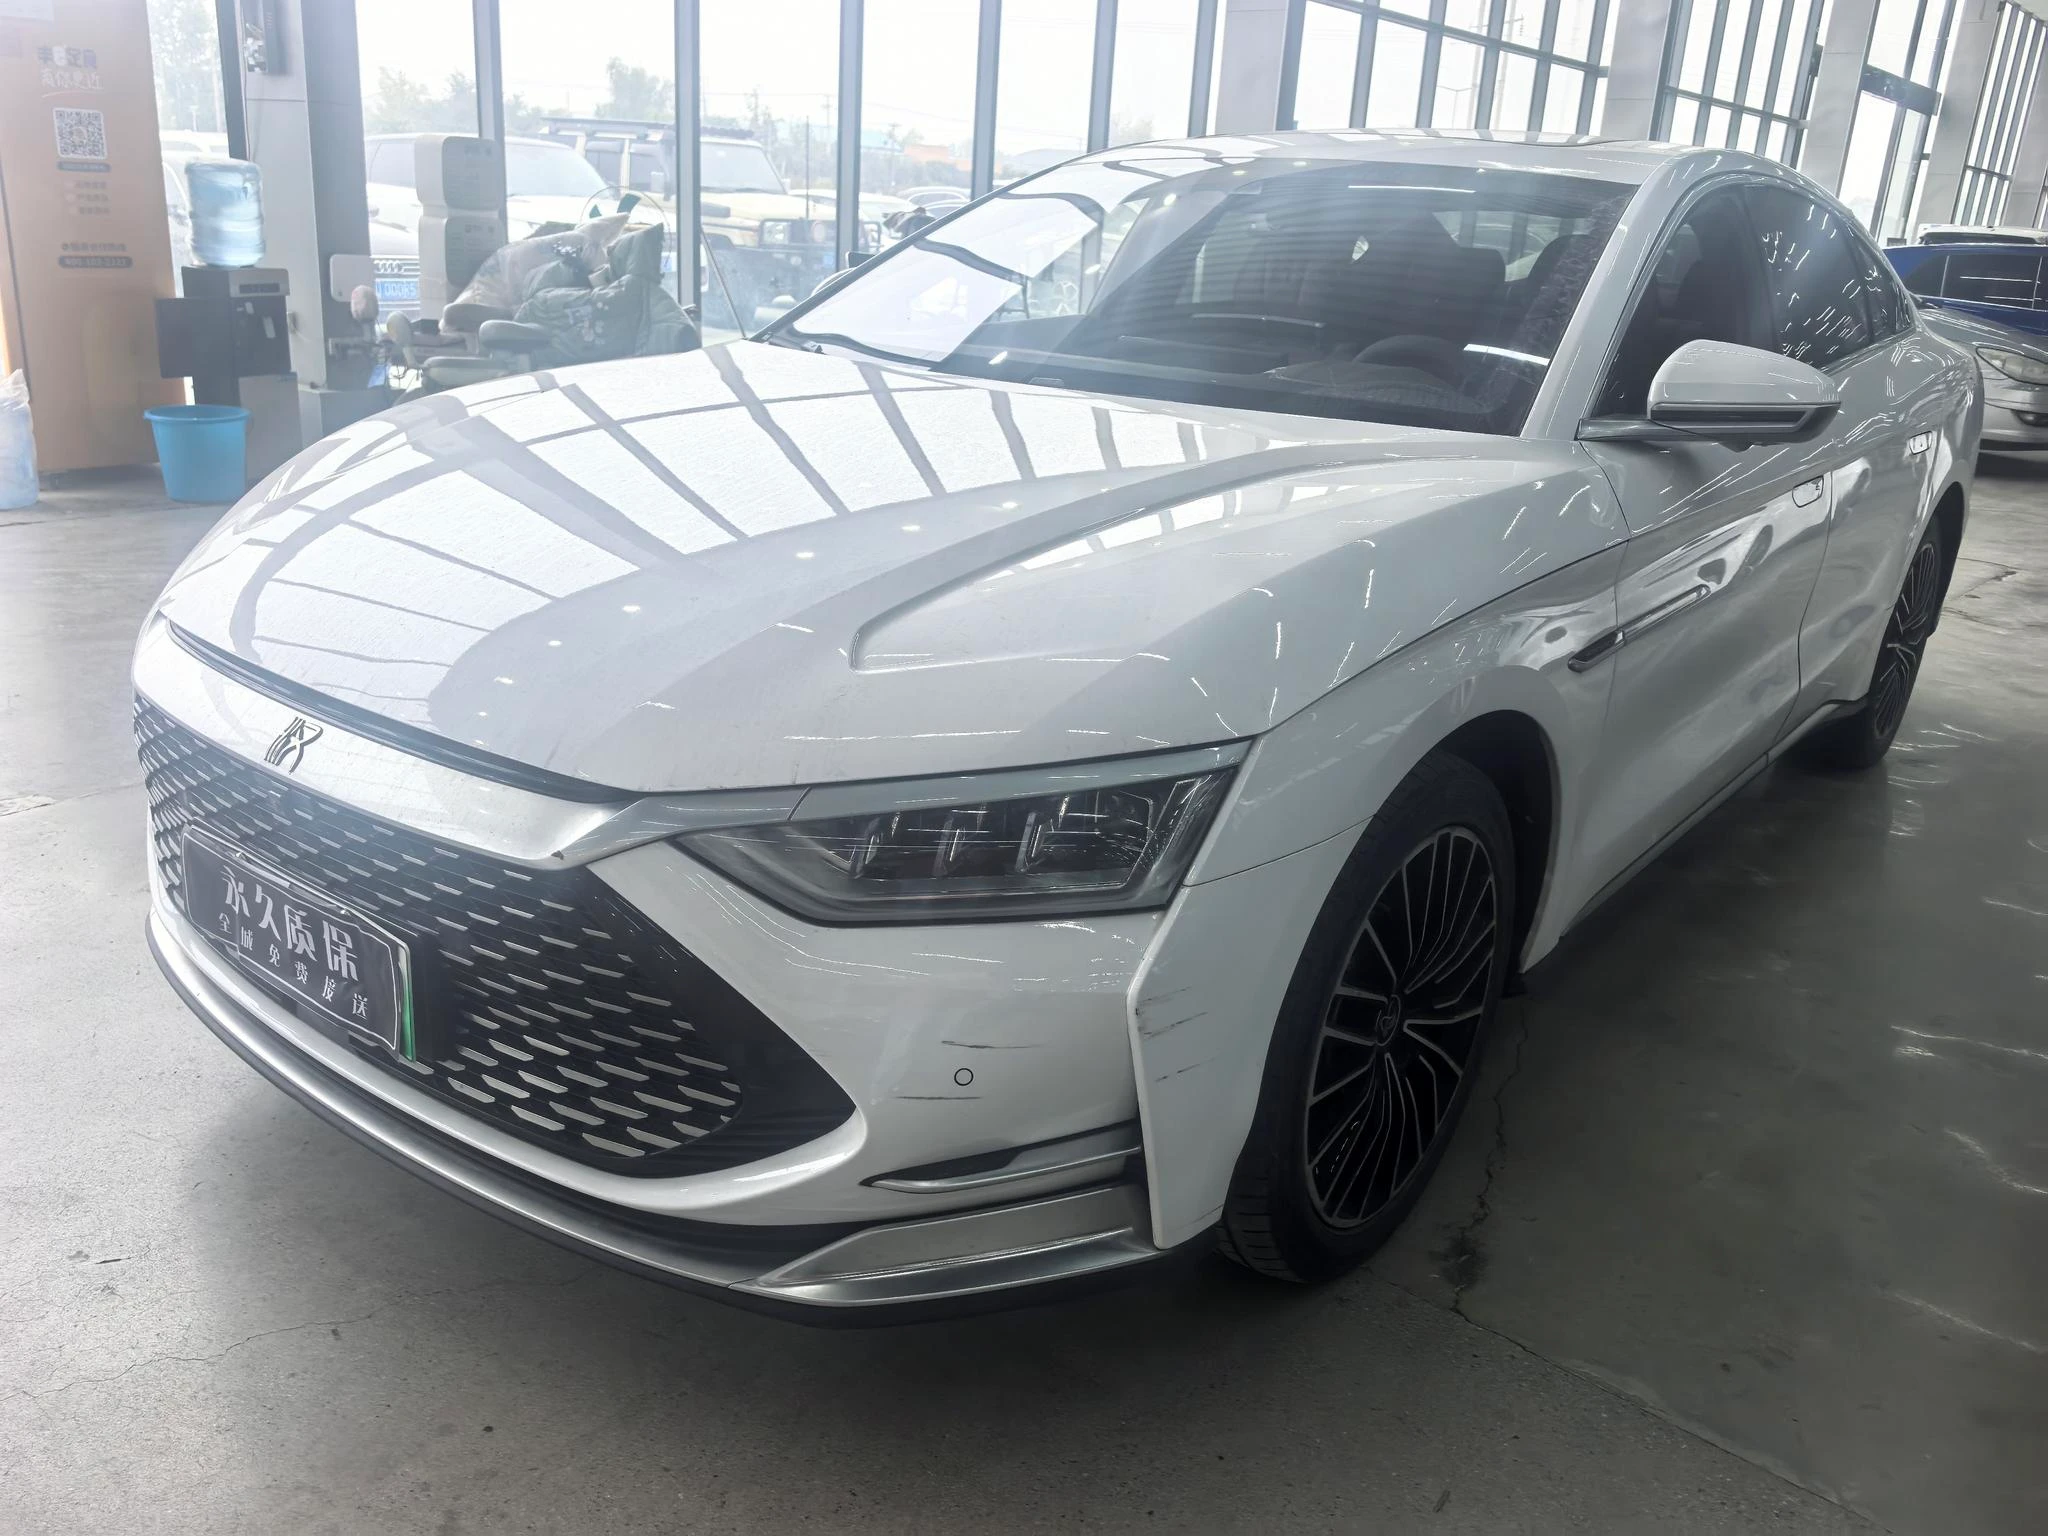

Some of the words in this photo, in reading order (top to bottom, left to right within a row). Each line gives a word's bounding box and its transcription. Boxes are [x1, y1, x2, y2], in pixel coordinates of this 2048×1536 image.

[219, 912, 368, 1020] 全城免费接送
[220, 865, 358, 981] 永久质保
